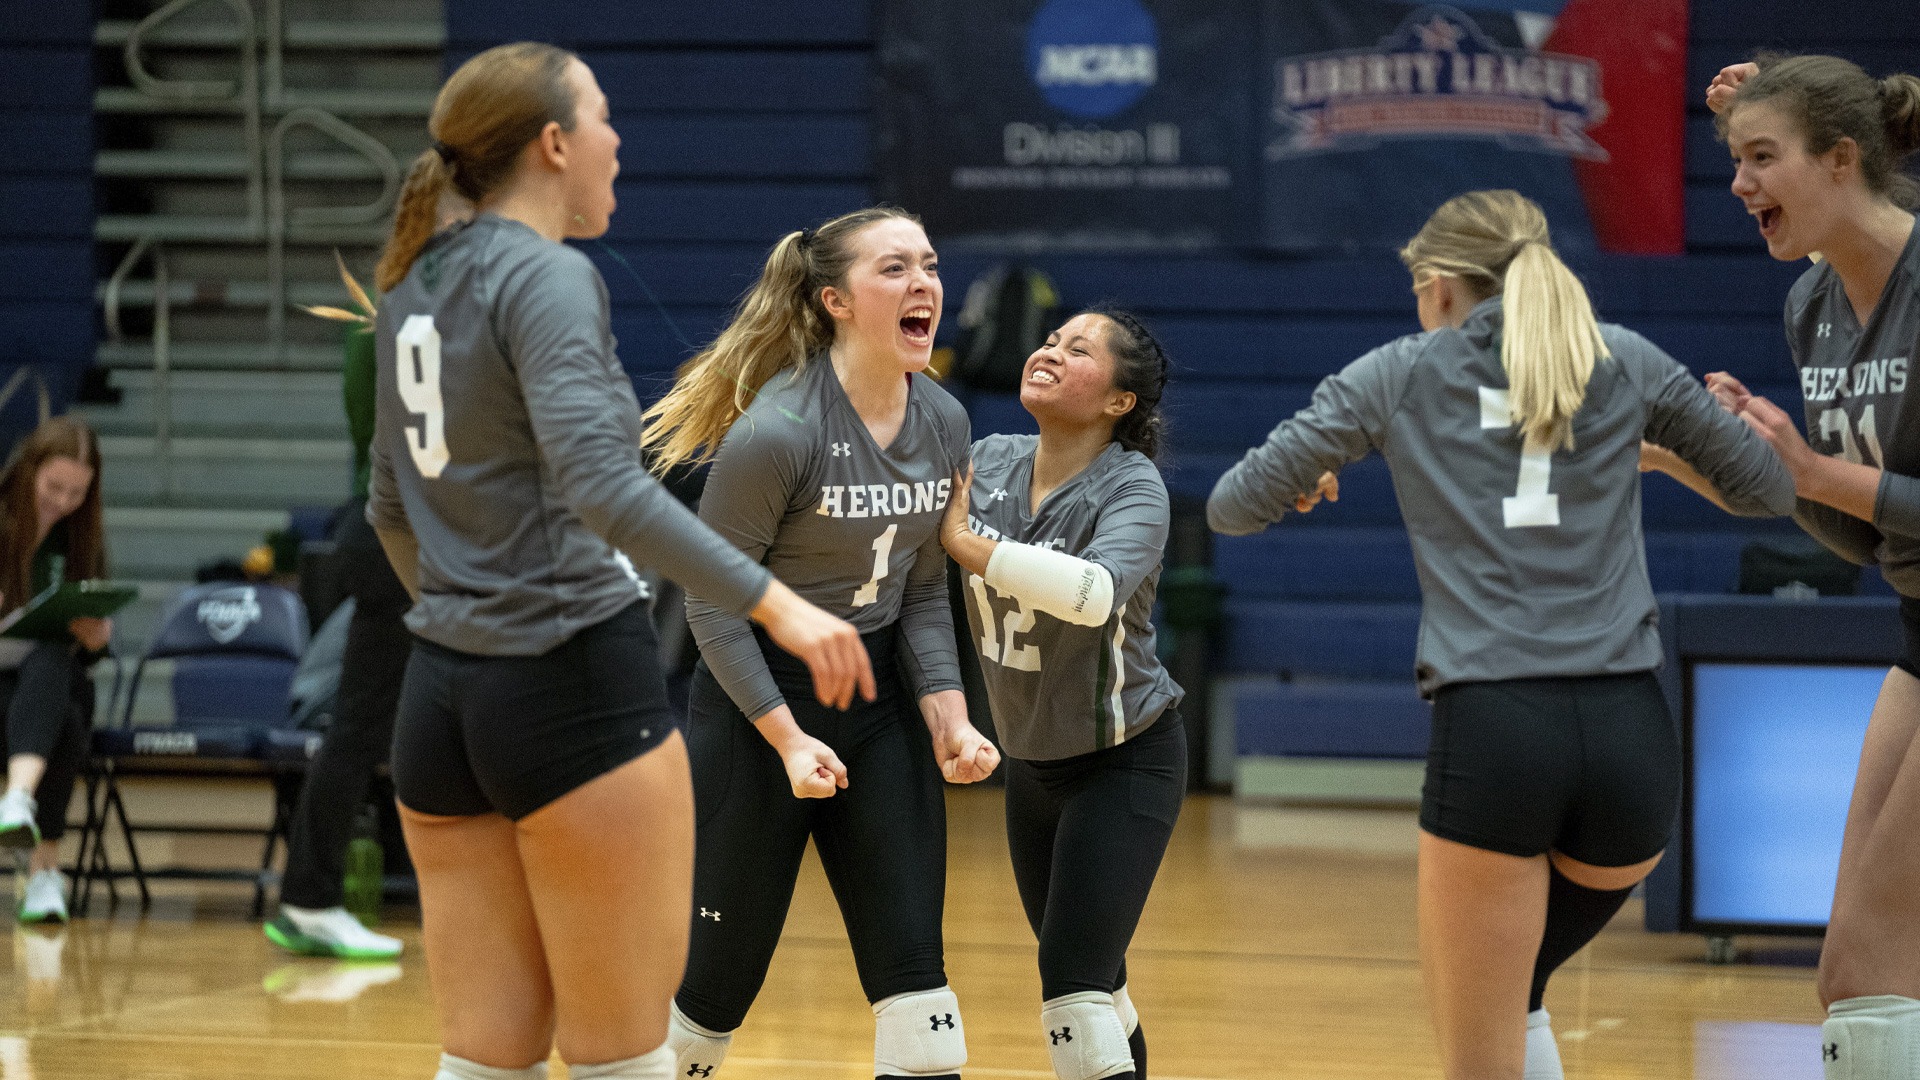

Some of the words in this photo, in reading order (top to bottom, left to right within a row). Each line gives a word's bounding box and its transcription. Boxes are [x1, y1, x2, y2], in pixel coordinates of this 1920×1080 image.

[1283, 54, 1439, 99] LIBERTY
[1449, 52, 1600, 101] LEAGUE
[1003, 121, 1145, 166] Division
[396, 314, 451, 479] 9
[1800, 357, 1909, 401] HERONS
[815, 477, 951, 518] HERONS
[851, 523, 898, 607] 1
[968, 573, 1042, 672] 12
